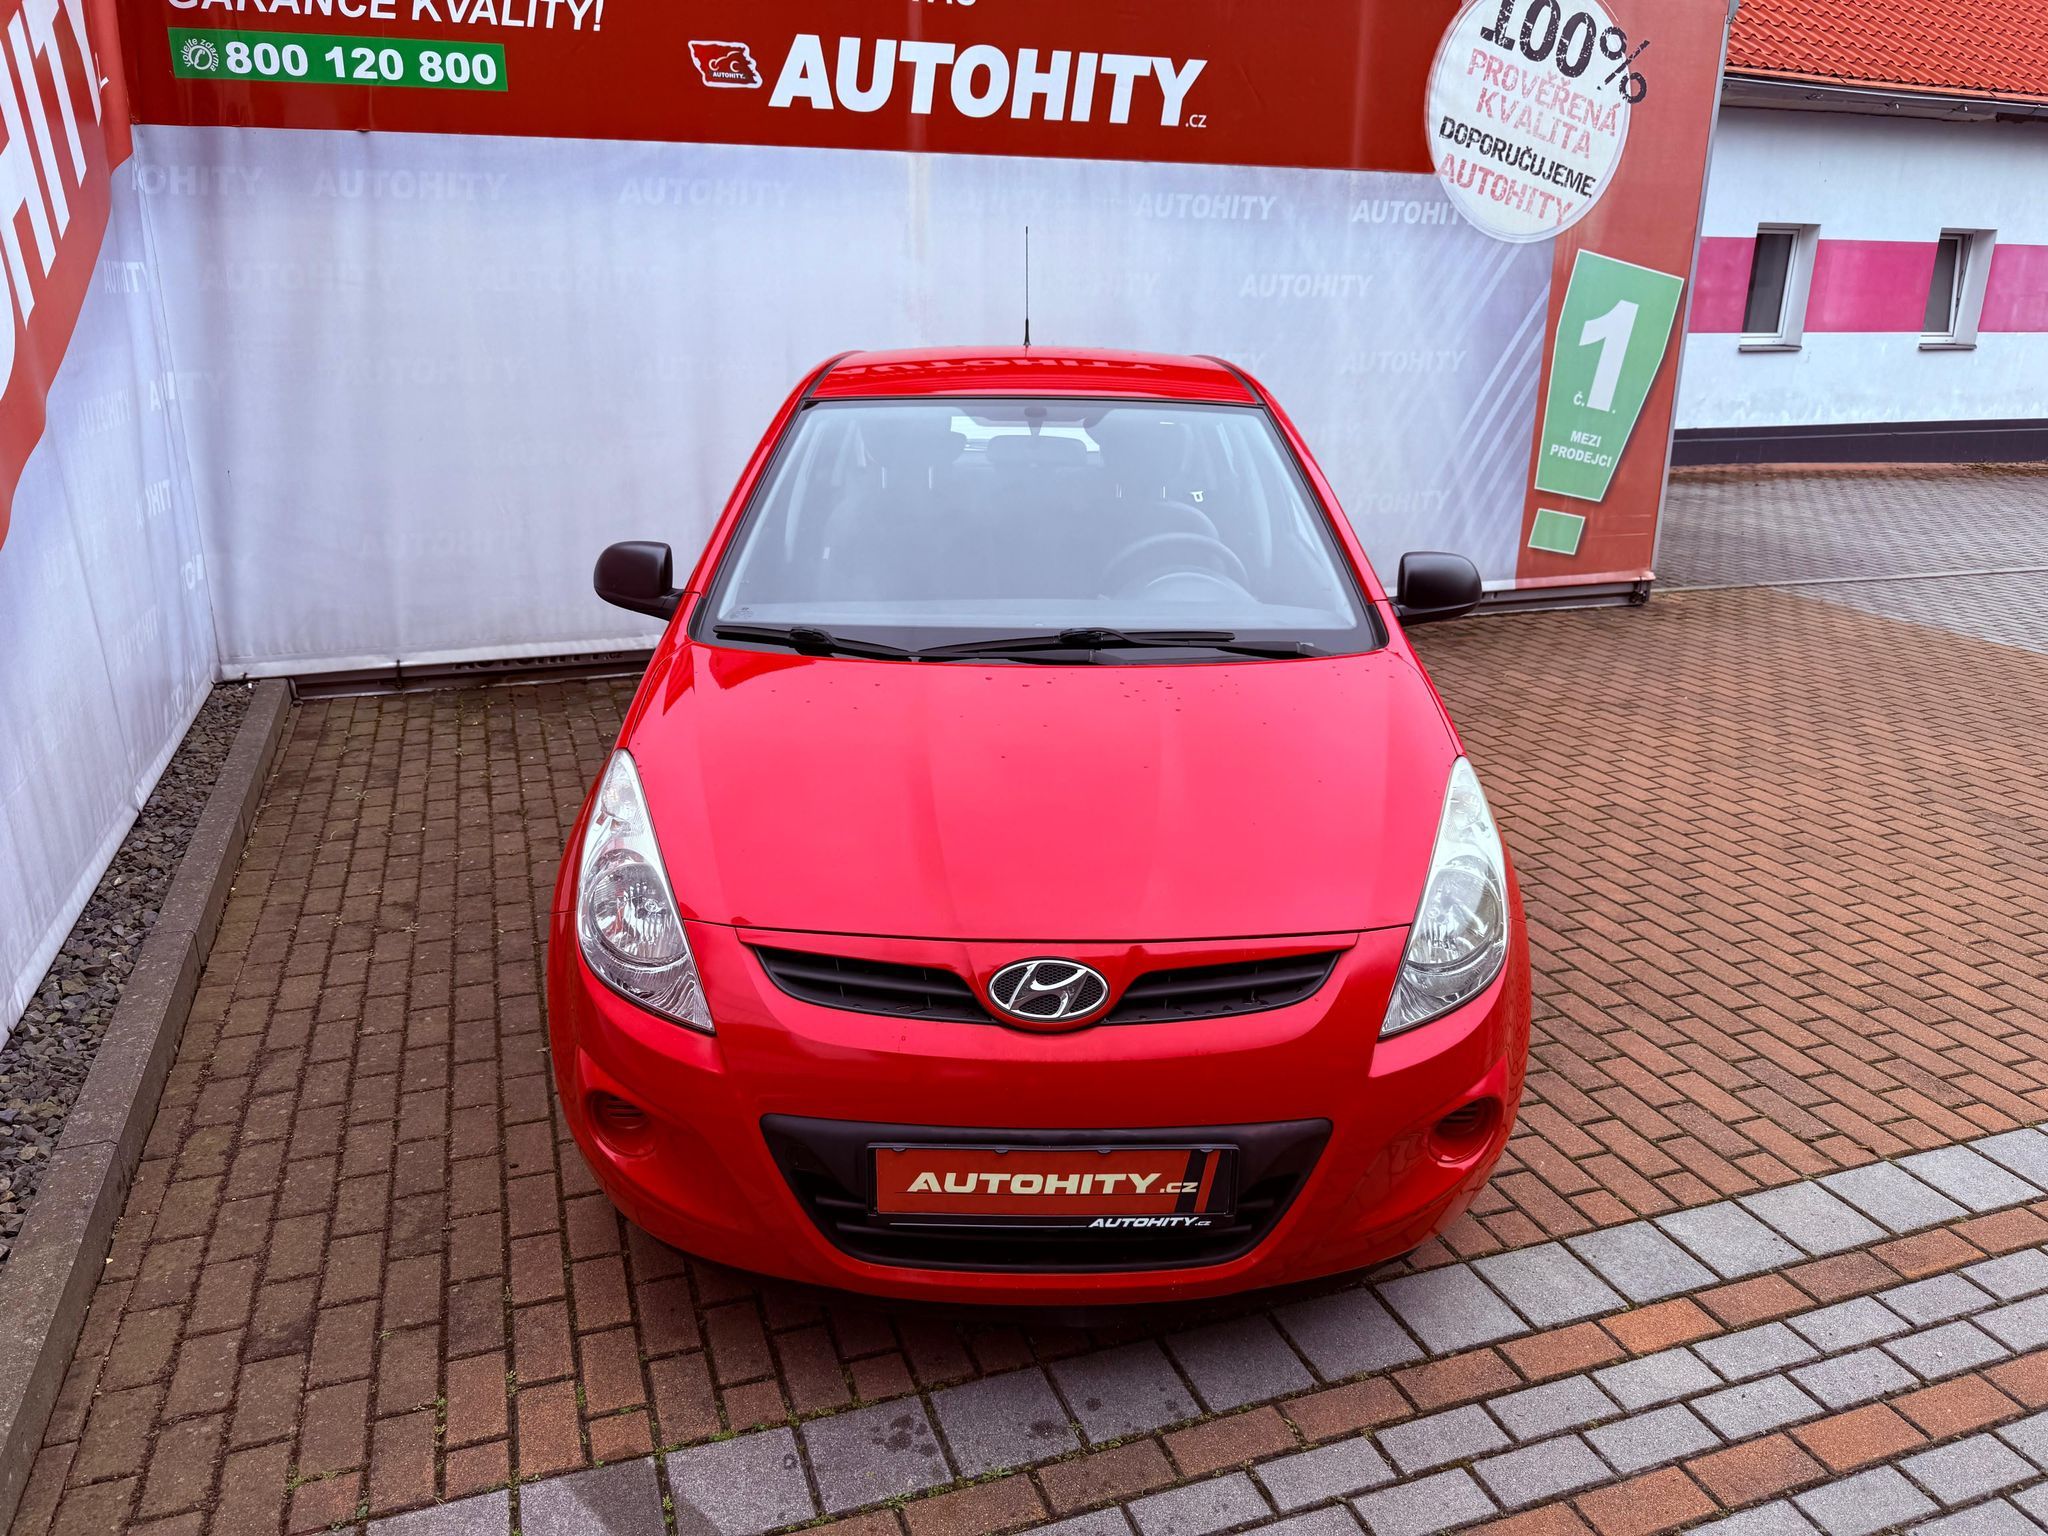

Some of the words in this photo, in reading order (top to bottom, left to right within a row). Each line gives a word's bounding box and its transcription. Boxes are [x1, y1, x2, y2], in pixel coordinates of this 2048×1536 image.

[412, 0, 606, 32] KVALITY!
[199, 38, 220, 72] zdarma
[225, 41, 309, 76] 800
[324, 46, 405, 81] 120
[418, 50, 498, 86] 800
[1480, 0, 1651, 104] 100%
[1466, 47, 1622, 137] PROVĚŘENÁ
[1476, 86, 1592, 160] KVALITA
[1438, 115, 1597, 199] DOPORUČUJEME
[311, 167, 509, 200] AUTOHITY
[618, 176, 796, 207] AUTOHITY
[1438, 153, 1574, 226] AUTOHITY
[1136, 192, 1278, 221] AUTOHITY
[1351, 198, 1472, 226] AUTOHIT
[1239, 273, 1375, 299] AUTOHITY
[1570, 430, 1602, 448] MEZI
[1549, 444, 1613, 468] PRODEJCI
